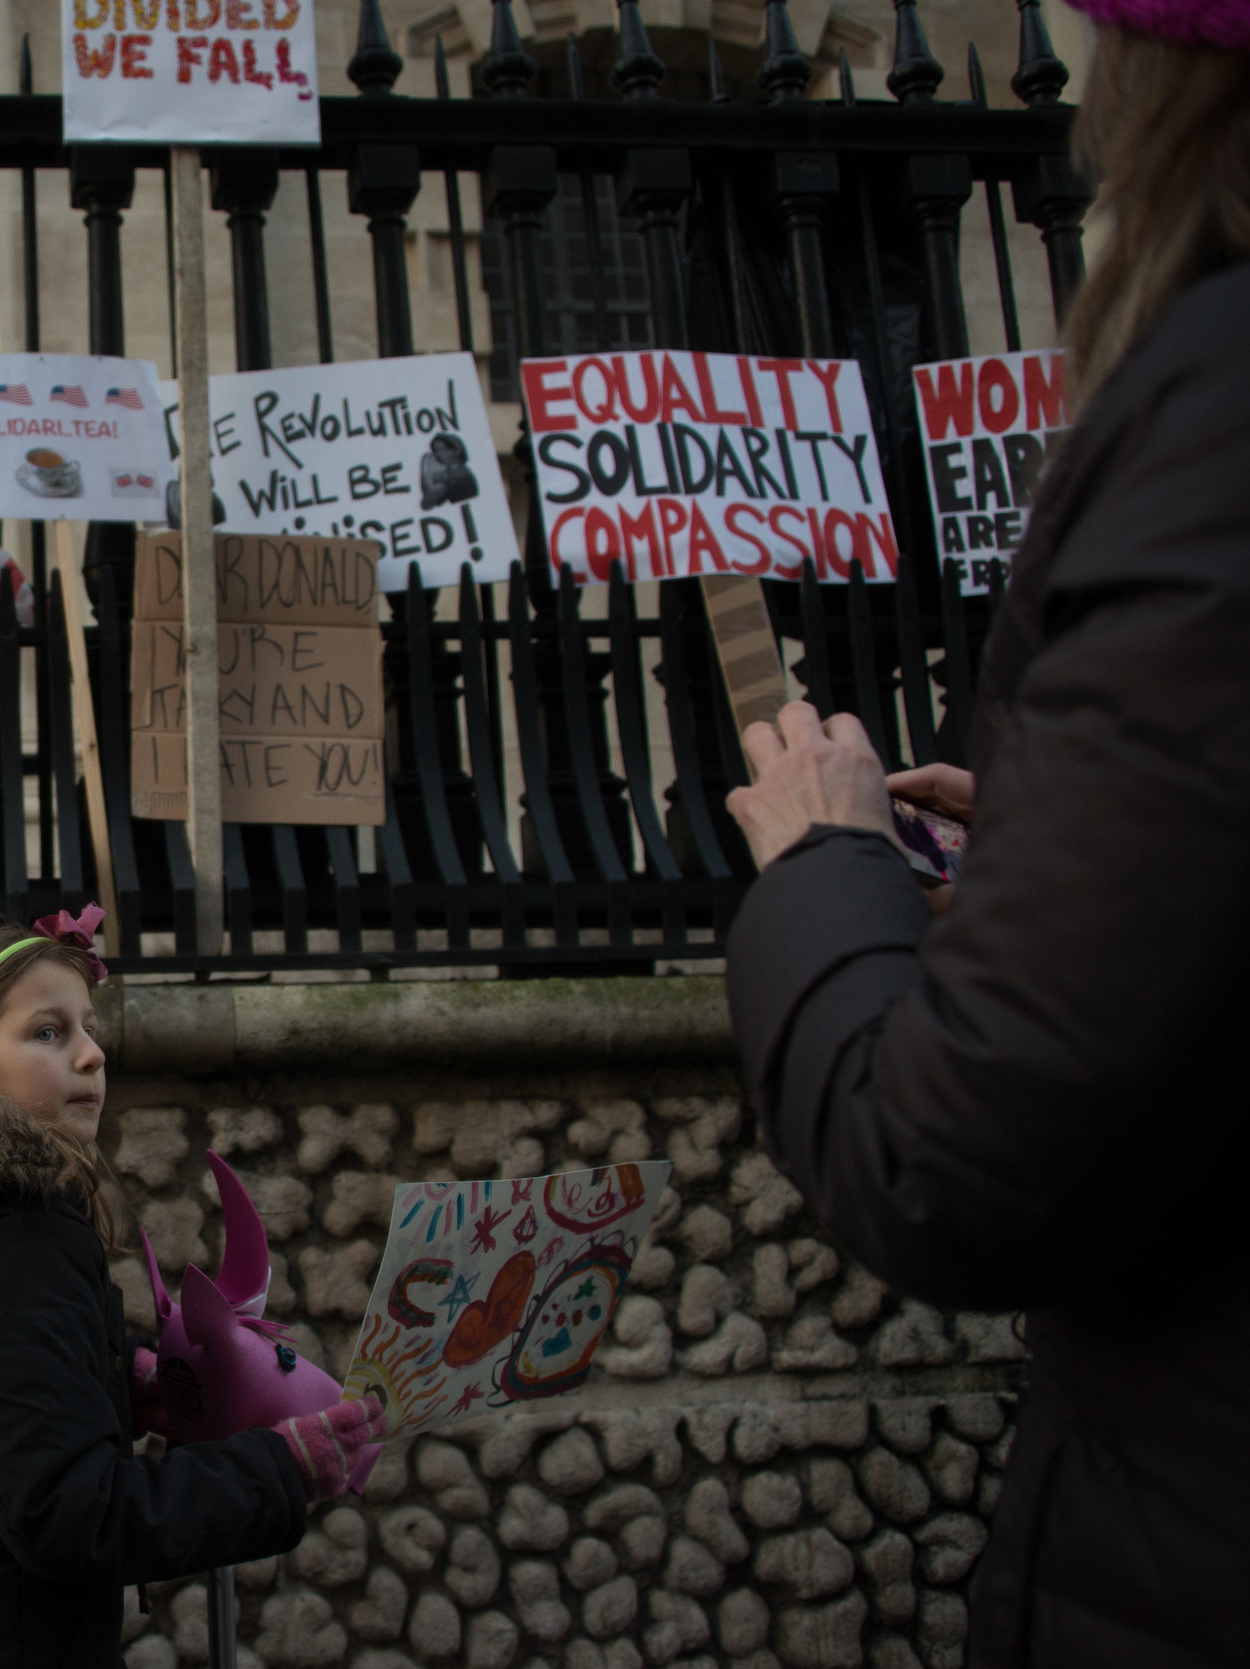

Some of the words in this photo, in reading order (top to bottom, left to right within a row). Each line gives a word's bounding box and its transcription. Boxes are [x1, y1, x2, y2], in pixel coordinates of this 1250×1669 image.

[73, 0, 298, 31] DIVIDED
[73, 33, 153, 79] WE
[521, 350, 844, 433] EQUALITY
[164, 402, 242, 461] TE
[348, 462, 411, 501] BE
[538, 422, 873, 504] SOLIDARITY
[549, 497, 901, 584] COMPASSION
[943, 510, 1023, 553] ARE
[271, 682, 364, 730] AND
[304, 741, 380, 792] YOU!
